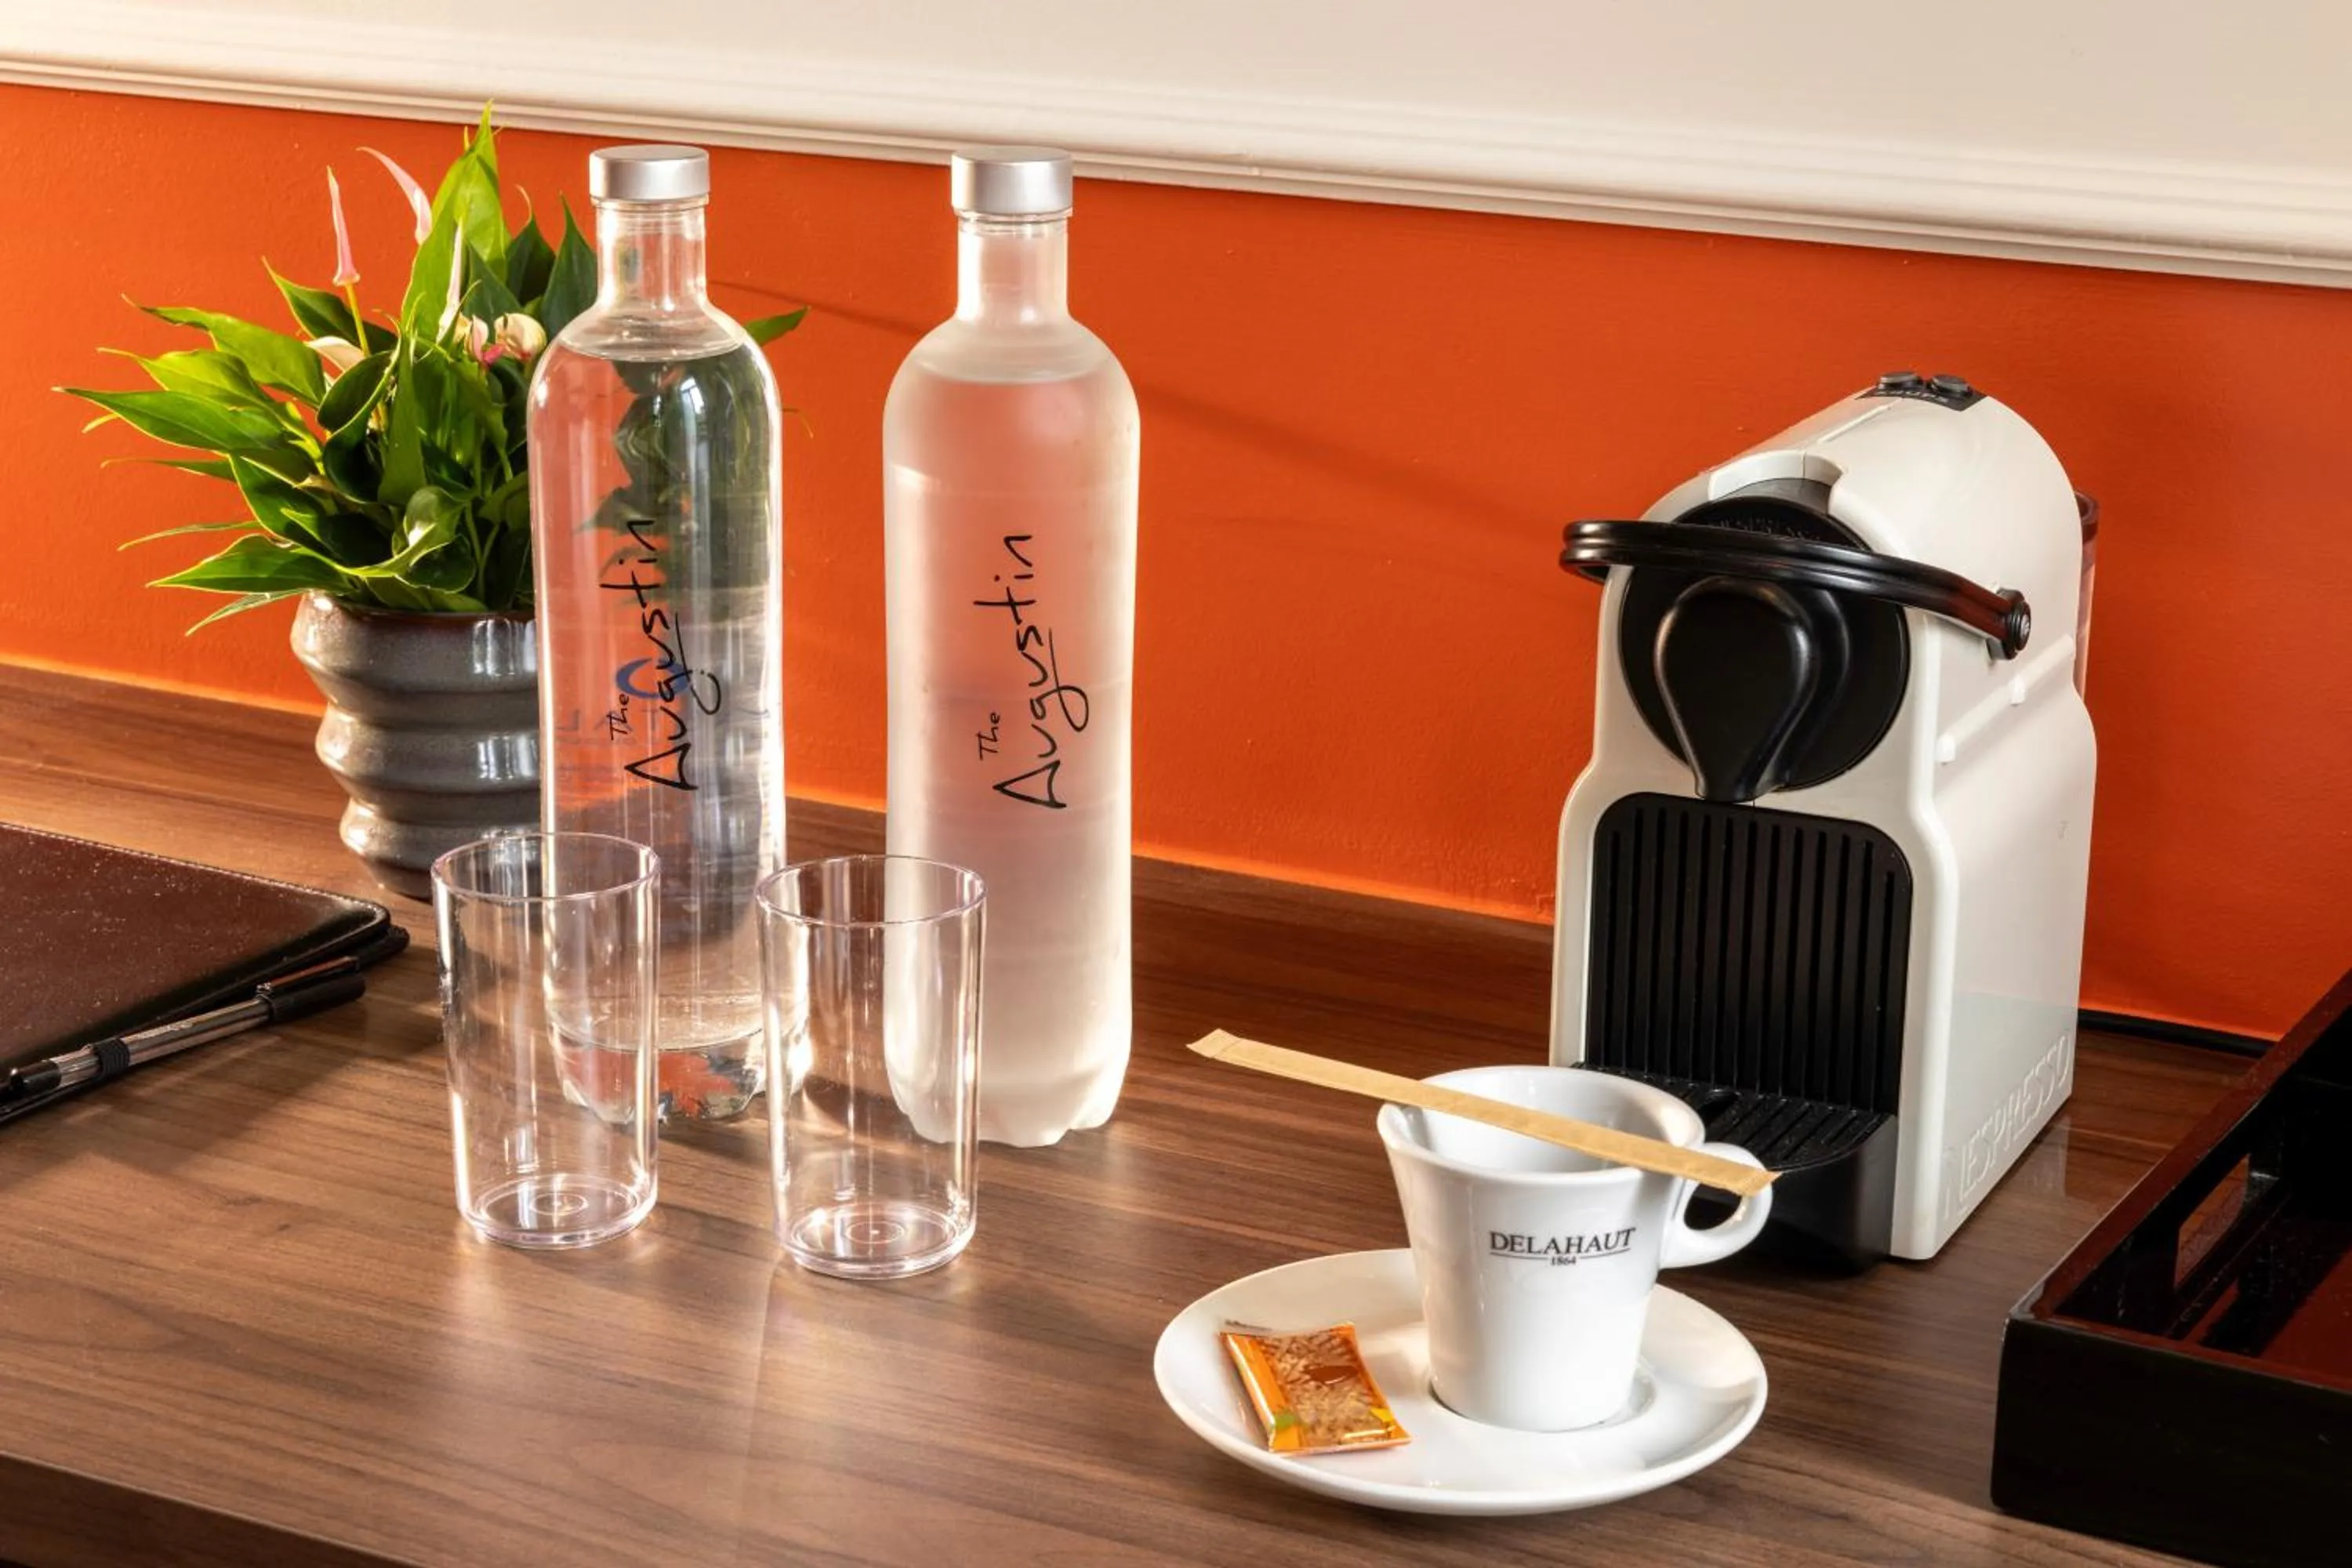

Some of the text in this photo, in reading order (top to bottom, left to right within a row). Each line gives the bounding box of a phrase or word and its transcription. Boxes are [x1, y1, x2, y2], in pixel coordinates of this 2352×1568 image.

[600, 520, 720, 790] Augustin
[973, 535, 1089, 808] Augustin
[610, 694, 630, 741] The
[975, 711, 1000, 760] The
[1489, 1227, 1636, 1254] DELAHAUT
[1550, 1255, 1577, 1266] 1864
